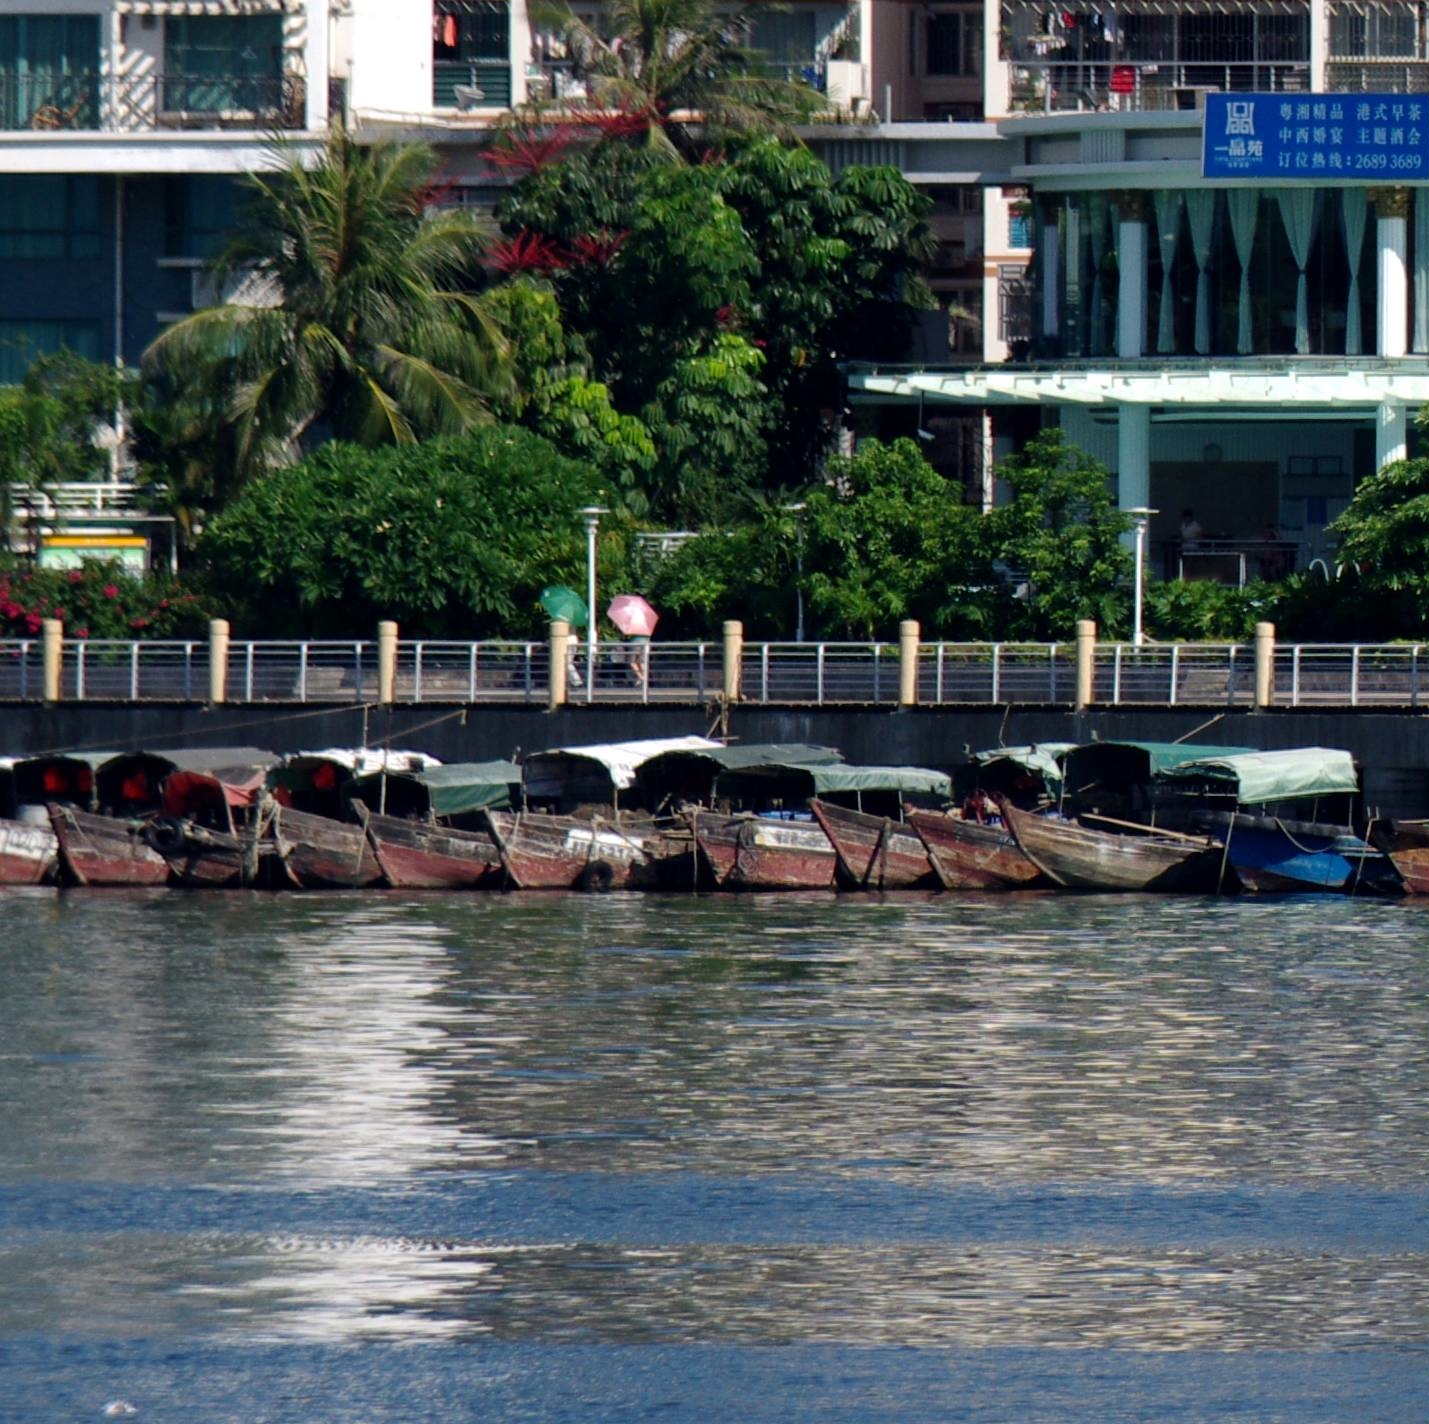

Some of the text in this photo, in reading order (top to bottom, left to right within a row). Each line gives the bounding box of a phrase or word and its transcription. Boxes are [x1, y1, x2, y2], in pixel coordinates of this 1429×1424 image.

[1280, 103, 1421, 122] 粤湘精品 港式早茶
[1279, 127, 1421, 145] 中西婚宴 主题酒会
[1355, 153, 1387, 169] 2689
[1389, 153, 1421, 169] 3689
